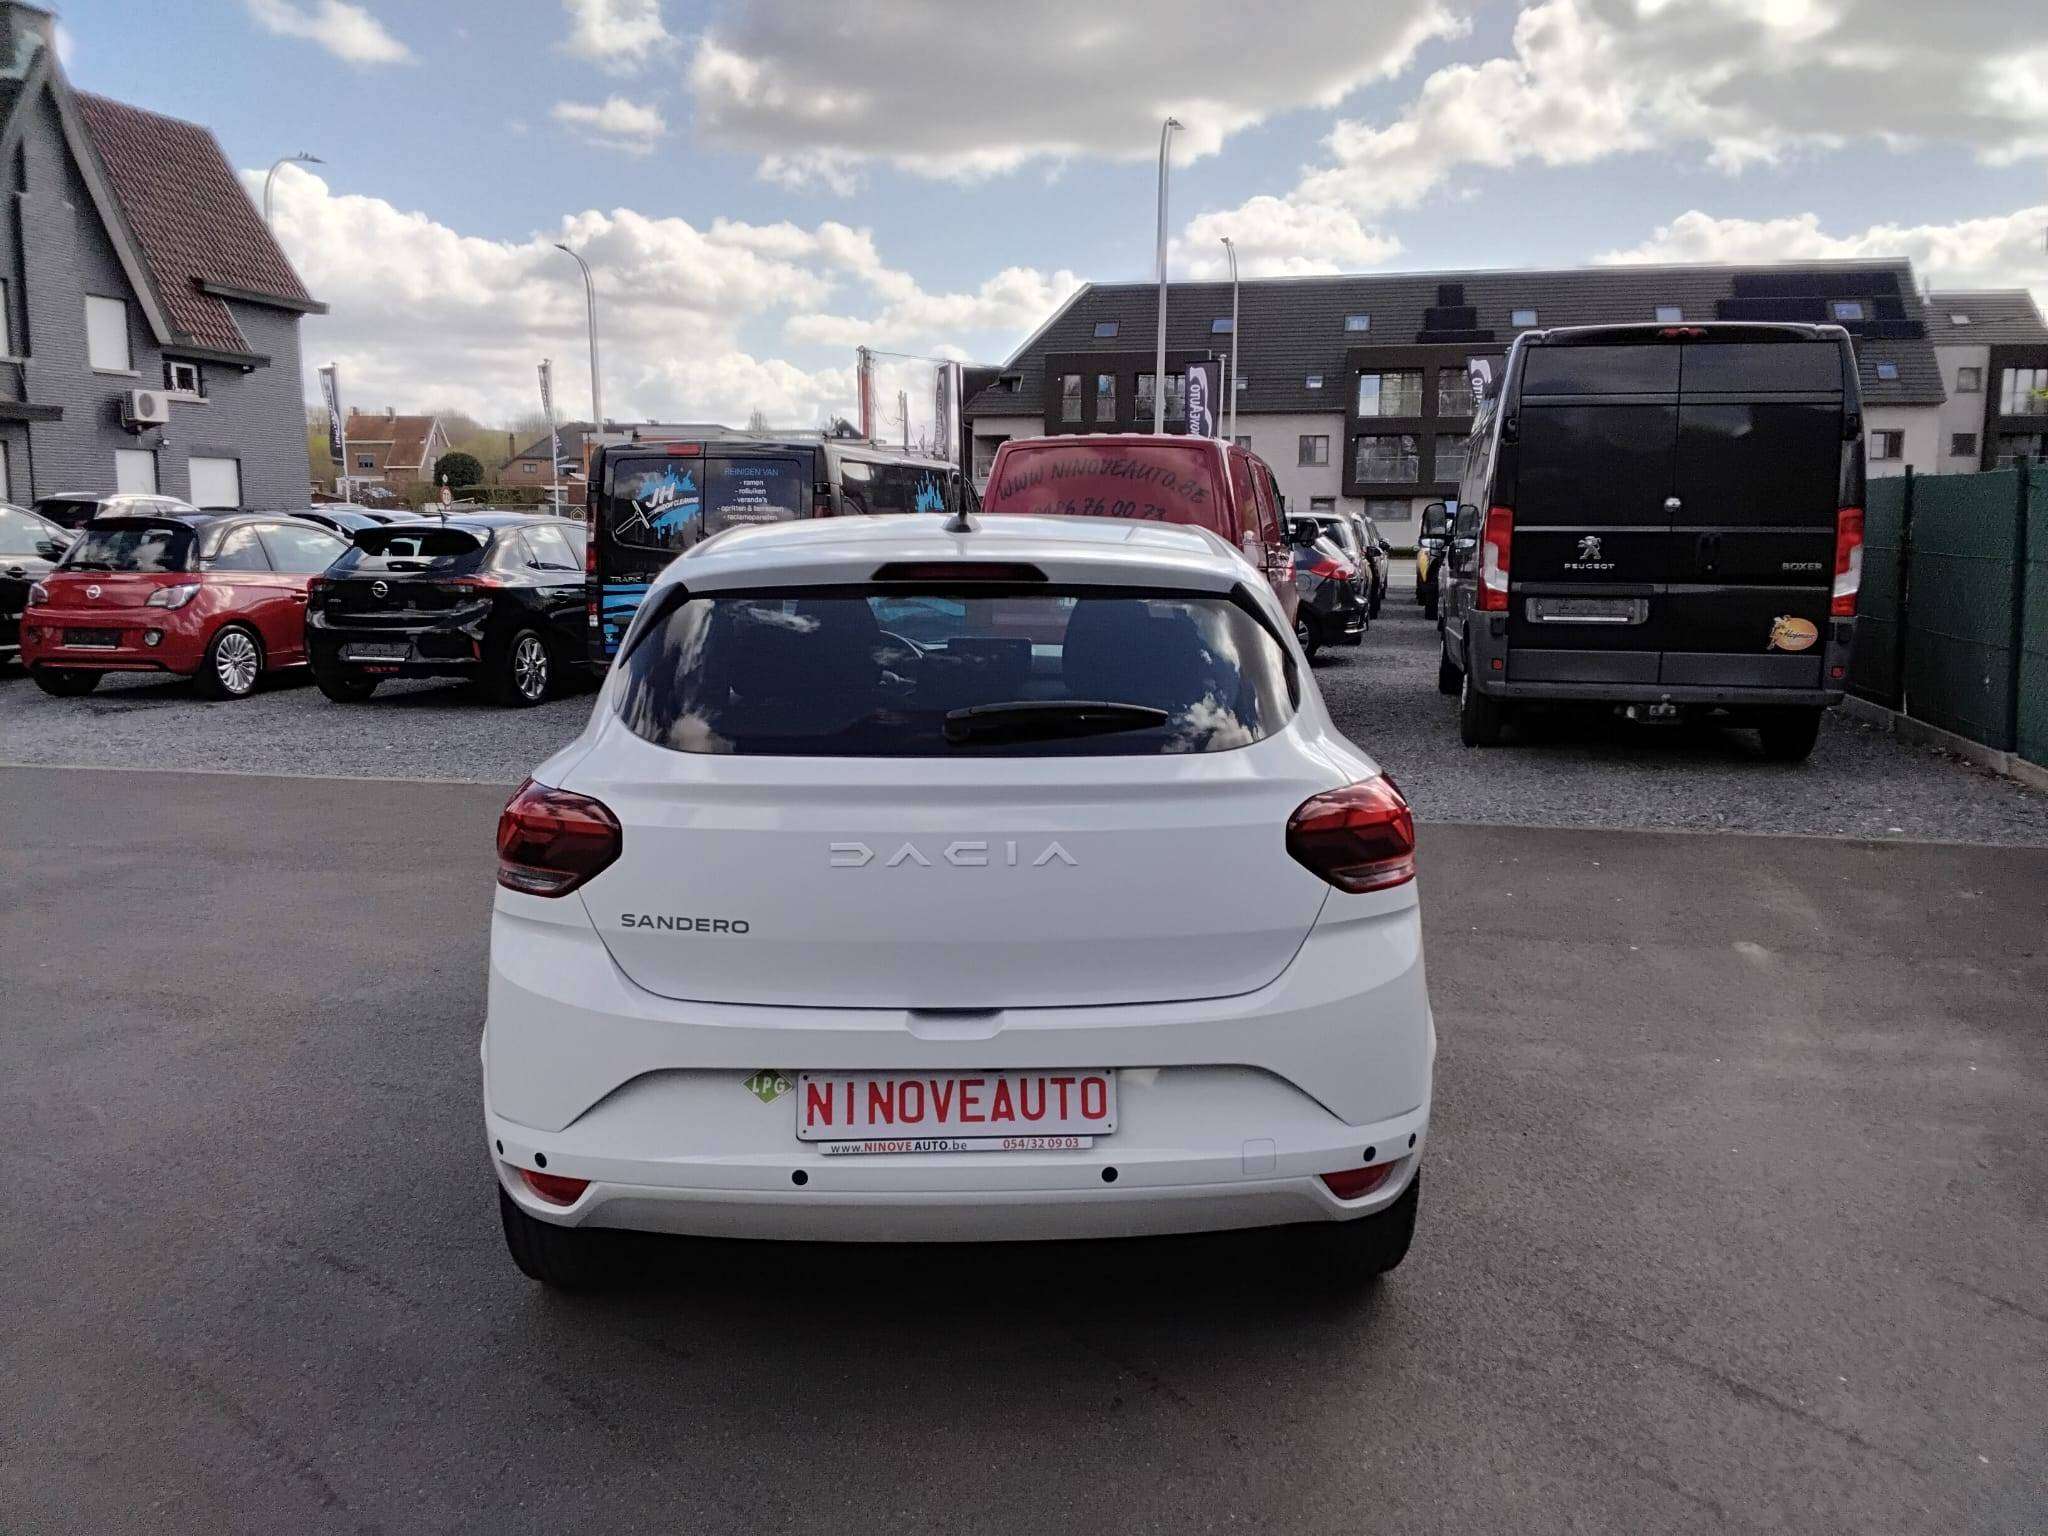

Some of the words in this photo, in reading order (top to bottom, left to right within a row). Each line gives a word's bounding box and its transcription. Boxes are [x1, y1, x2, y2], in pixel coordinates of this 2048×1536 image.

[645, 482, 675, 508] JH
[1782, 562, 1822, 570] BOXER
[829, 840, 1079, 868] DACIA
[620, 913, 751, 934] SANDERO
[752, 1078, 786, 1094] LPG
[806, 1076, 1107, 1126] NINOVEAUTO
[830, 1140, 968, 1153] www.NINOVEAUTO.be
[1002, 1138, 1044, 1150] 054/32
[1047, 1138, 1062, 1148] 09
[1065, 1137, 1079, 1148] 03
